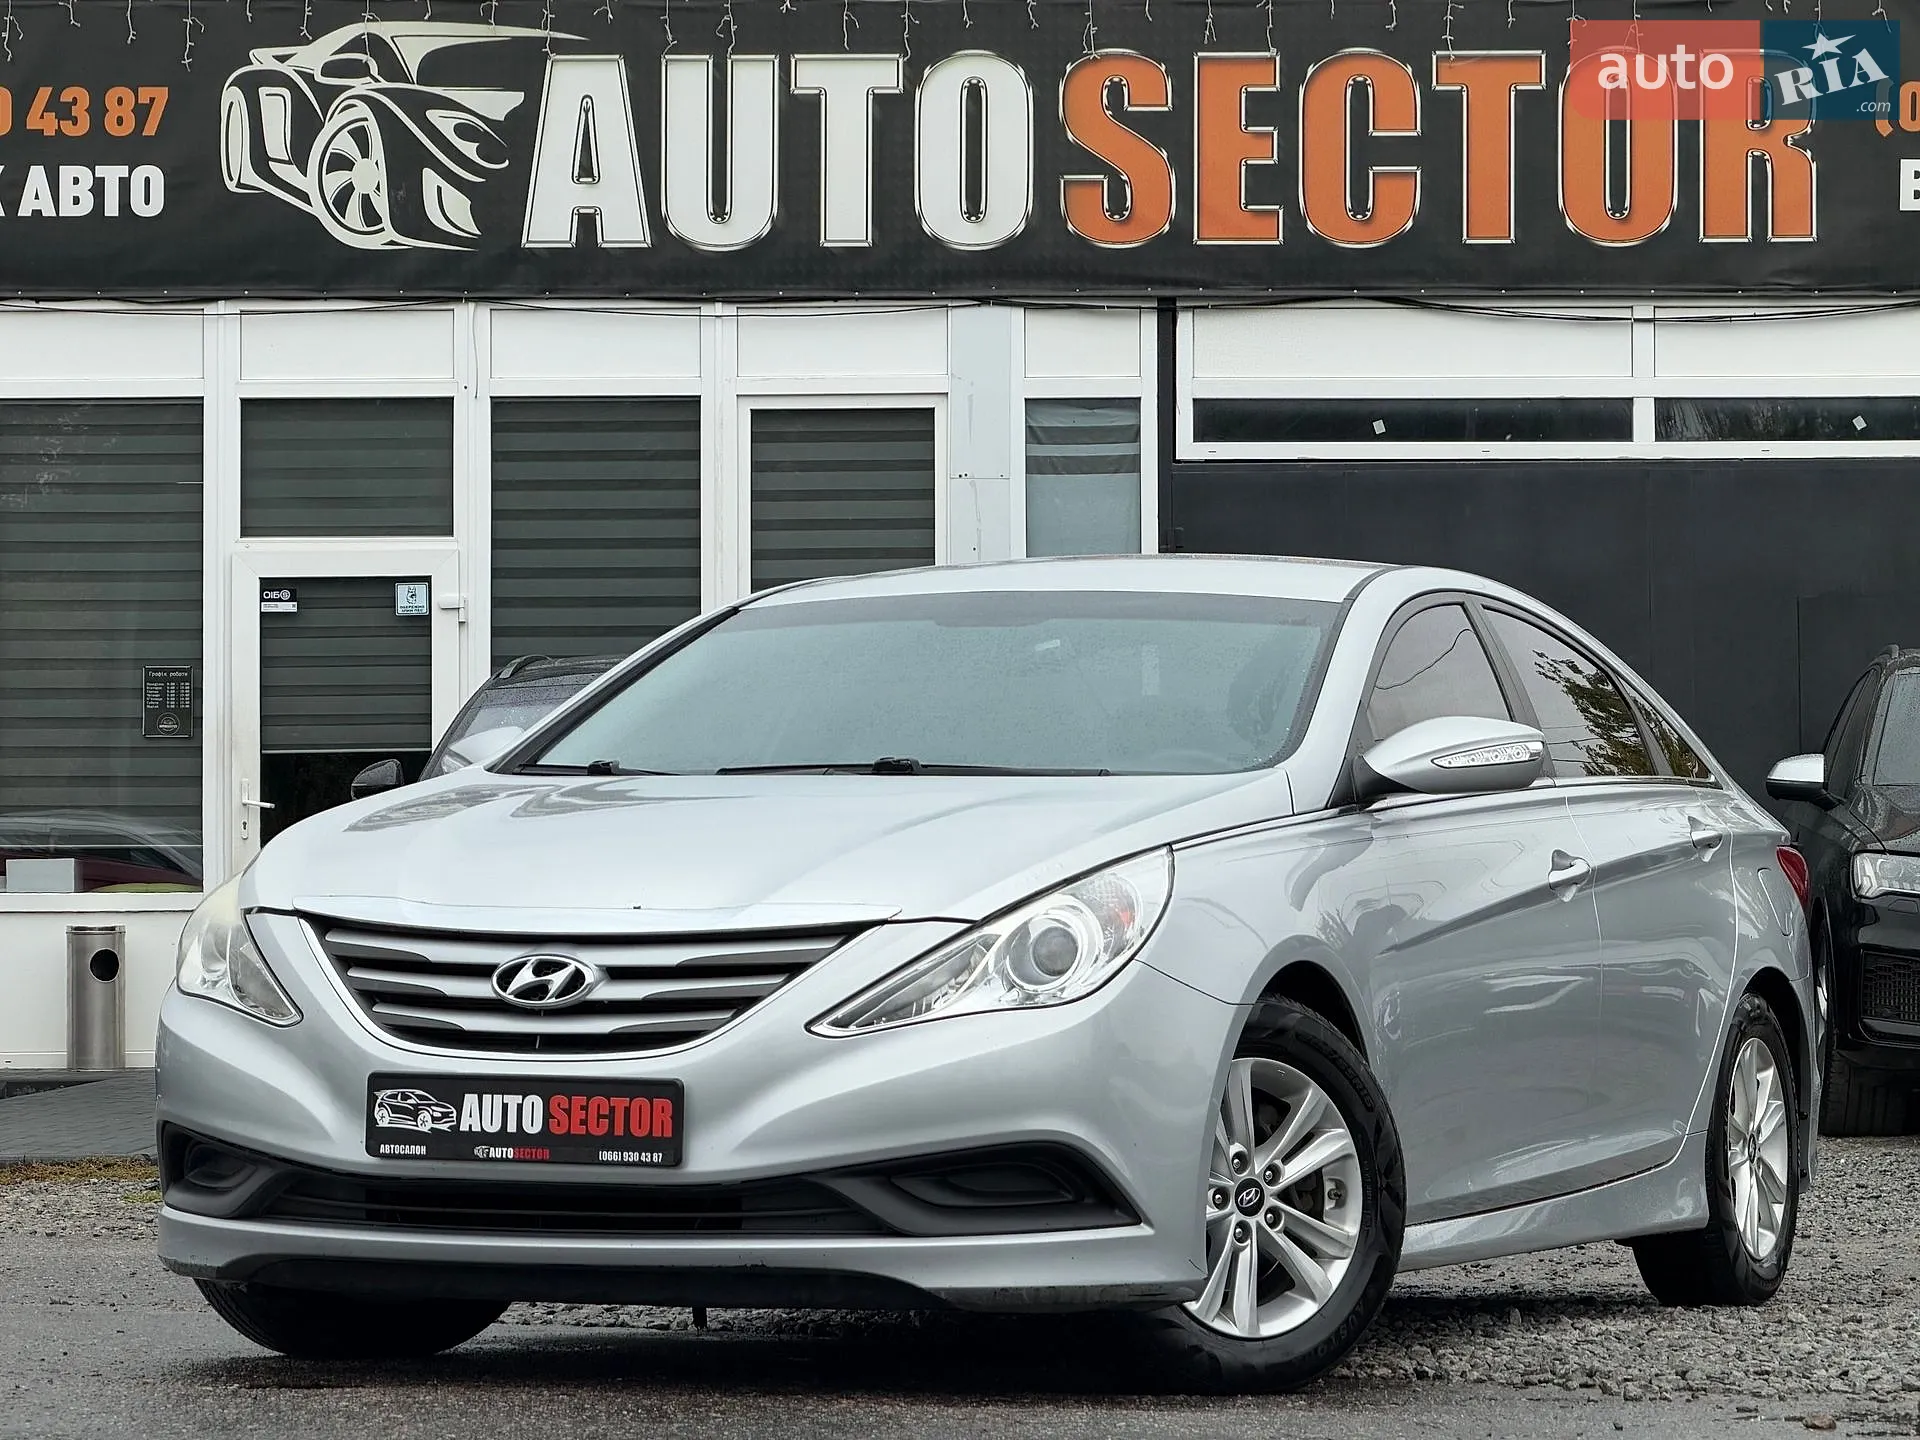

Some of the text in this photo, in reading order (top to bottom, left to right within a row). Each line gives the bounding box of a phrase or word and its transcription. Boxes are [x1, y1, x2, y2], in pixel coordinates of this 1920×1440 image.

[26, 86, 91, 137] 43
[104, 86, 169, 137] 87
[17, 164, 166, 218] АВТО
[459, 1093, 673, 1139] AUTO SECTOR
[379, 1144, 427, 1156] АВТОСАЛОН
[598, 1150, 663, 1163] (066) 930 43 87
